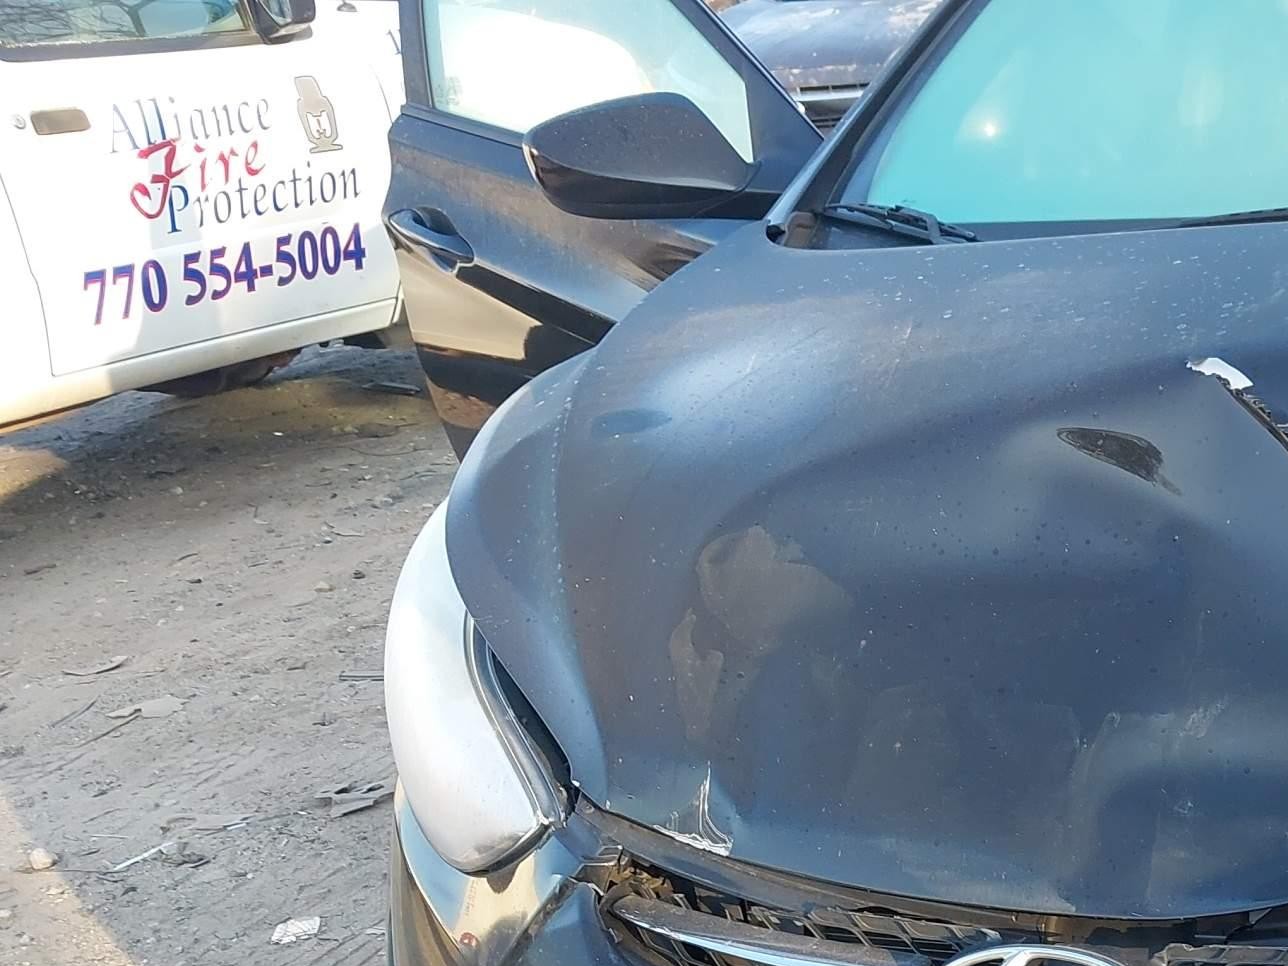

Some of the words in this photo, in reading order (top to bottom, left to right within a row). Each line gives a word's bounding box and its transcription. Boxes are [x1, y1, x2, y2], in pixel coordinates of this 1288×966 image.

[110, 97, 271, 154] Alliance
[130, 138, 265, 219] Fire
[166, 162, 361, 234] Protection
[83, 259, 168, 325] 770
[183, 223, 366, 306] 554-5004
